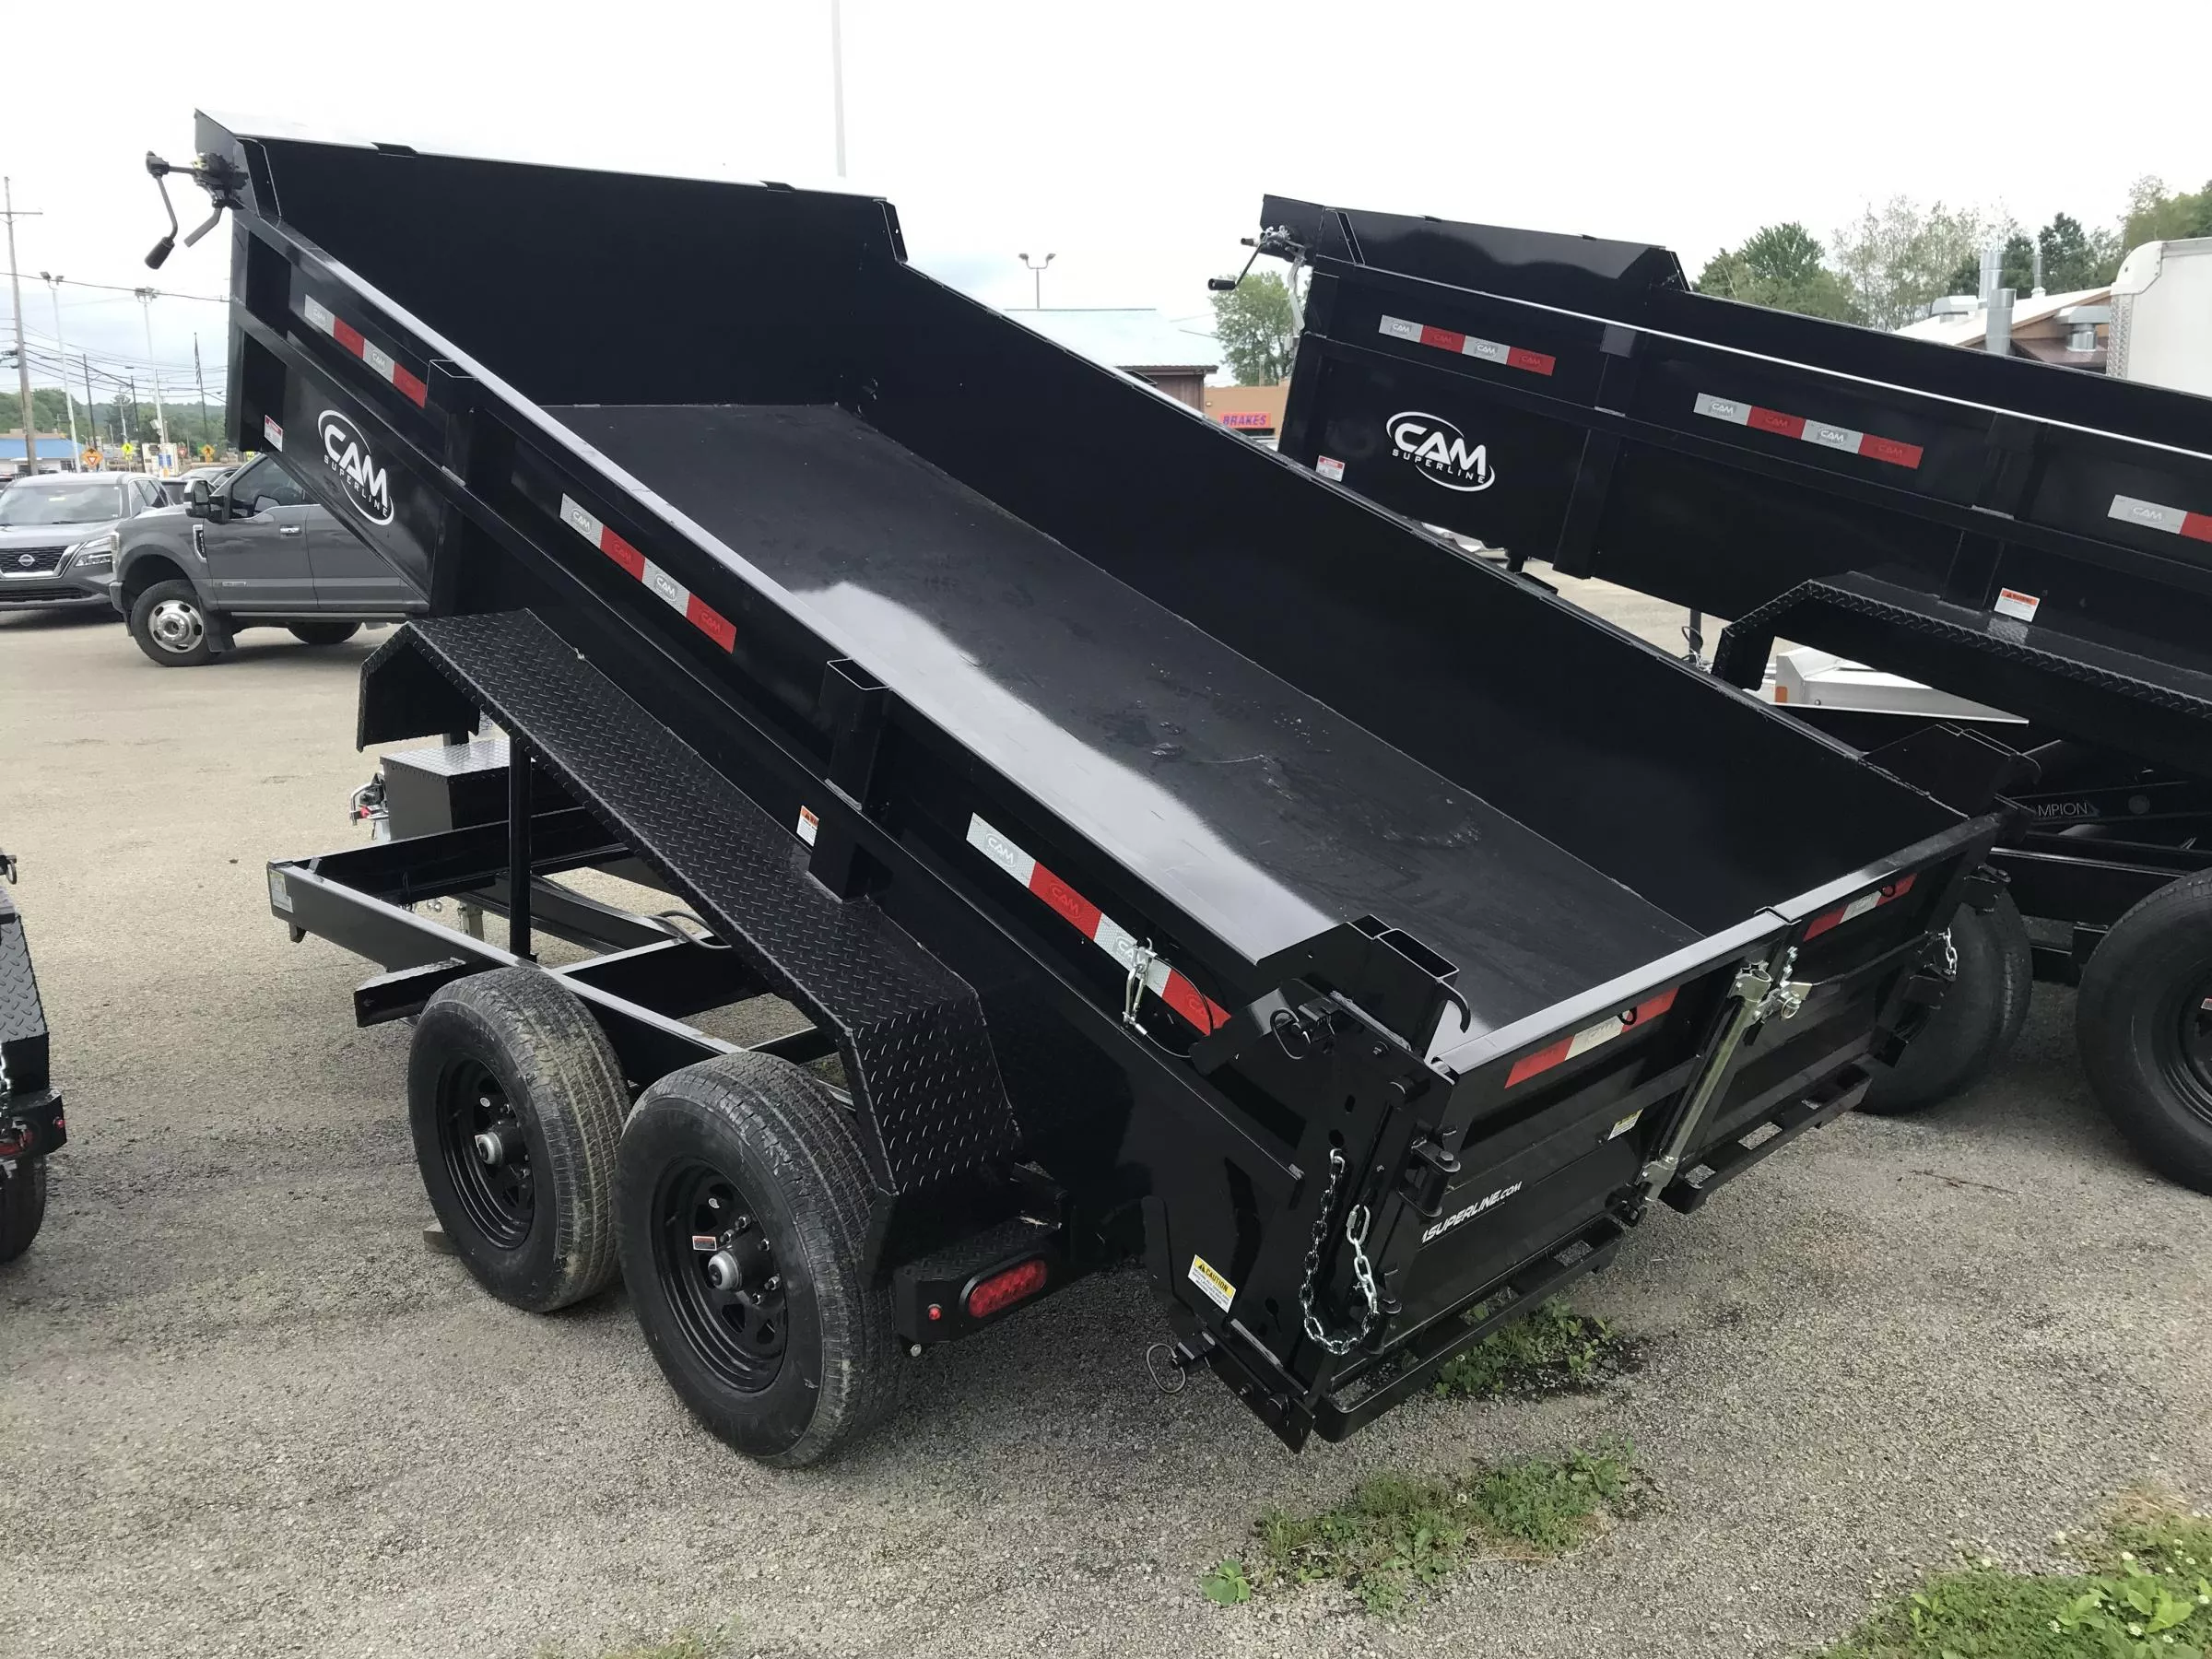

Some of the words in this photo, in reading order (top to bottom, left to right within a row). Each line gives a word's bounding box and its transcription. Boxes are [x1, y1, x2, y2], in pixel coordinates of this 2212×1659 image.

[1393, 324, 1410, 334] CAM
[1477, 344, 1496, 355] CAM
[1223, 414, 1266, 426] BRAKES
[1712, 403, 1734, 415] CAM
[1820, 429, 1843, 441] CAM
[324, 424, 387, 509] CAM
[1392, 448, 1485, 484] SUPERLINE
[1394, 422, 1486, 477] CAM
[324, 454, 387, 518] SUPERLINE
[2133, 507, 2163, 521] CAM
[572, 510, 590, 530] CAM
[614, 543, 632, 562] CAM
[656, 576, 676, 596] CAM
[701, 612, 721, 633] CAM
[988, 837, 1014, 865] CAM
[1051, 885, 1079, 915] CAM
[1206, 1268, 1229, 1292] CAUTION
